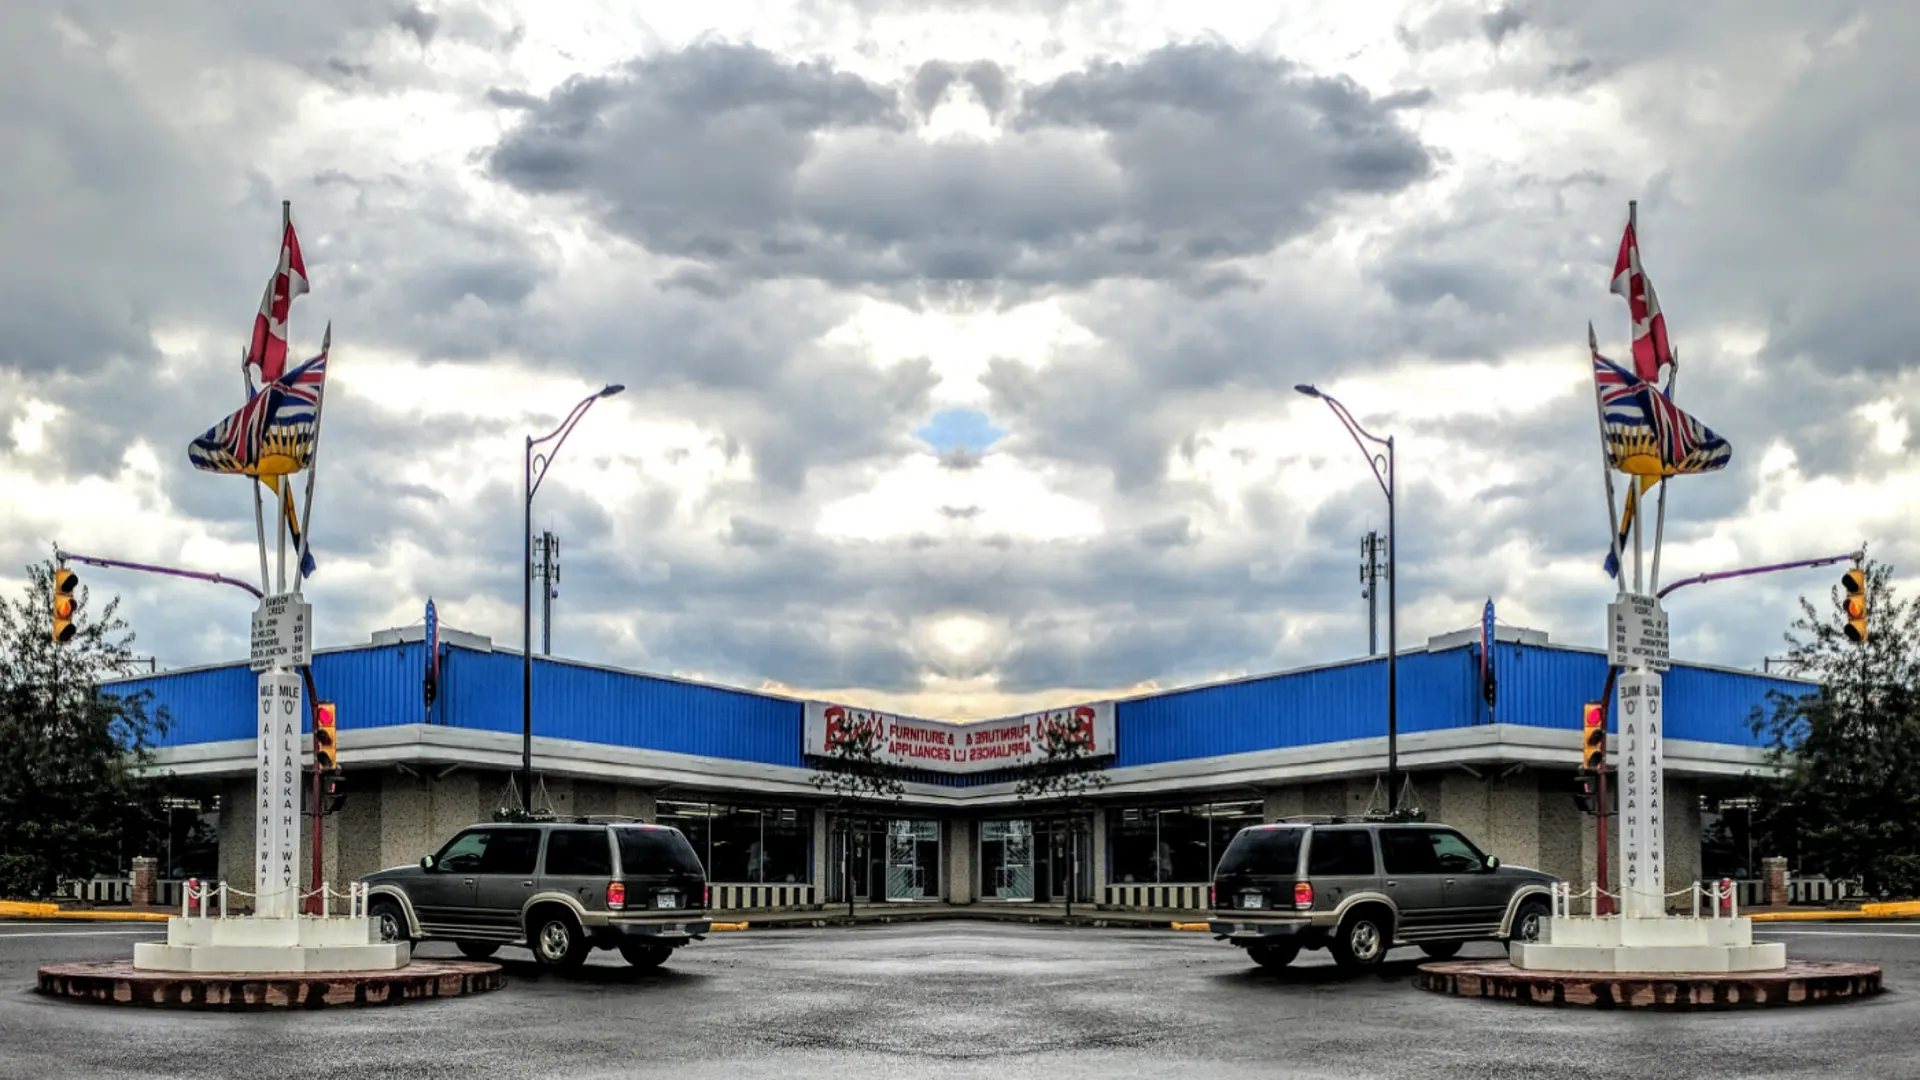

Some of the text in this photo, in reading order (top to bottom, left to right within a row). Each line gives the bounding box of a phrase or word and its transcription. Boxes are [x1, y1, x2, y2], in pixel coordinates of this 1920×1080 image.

[279, 684, 299, 699] MILE
[889, 724, 954, 745] FURNITURE &
[888, 741, 950, 761] APPLIANCES
[282, 723, 292, 887] ALASKA HI-WAY
